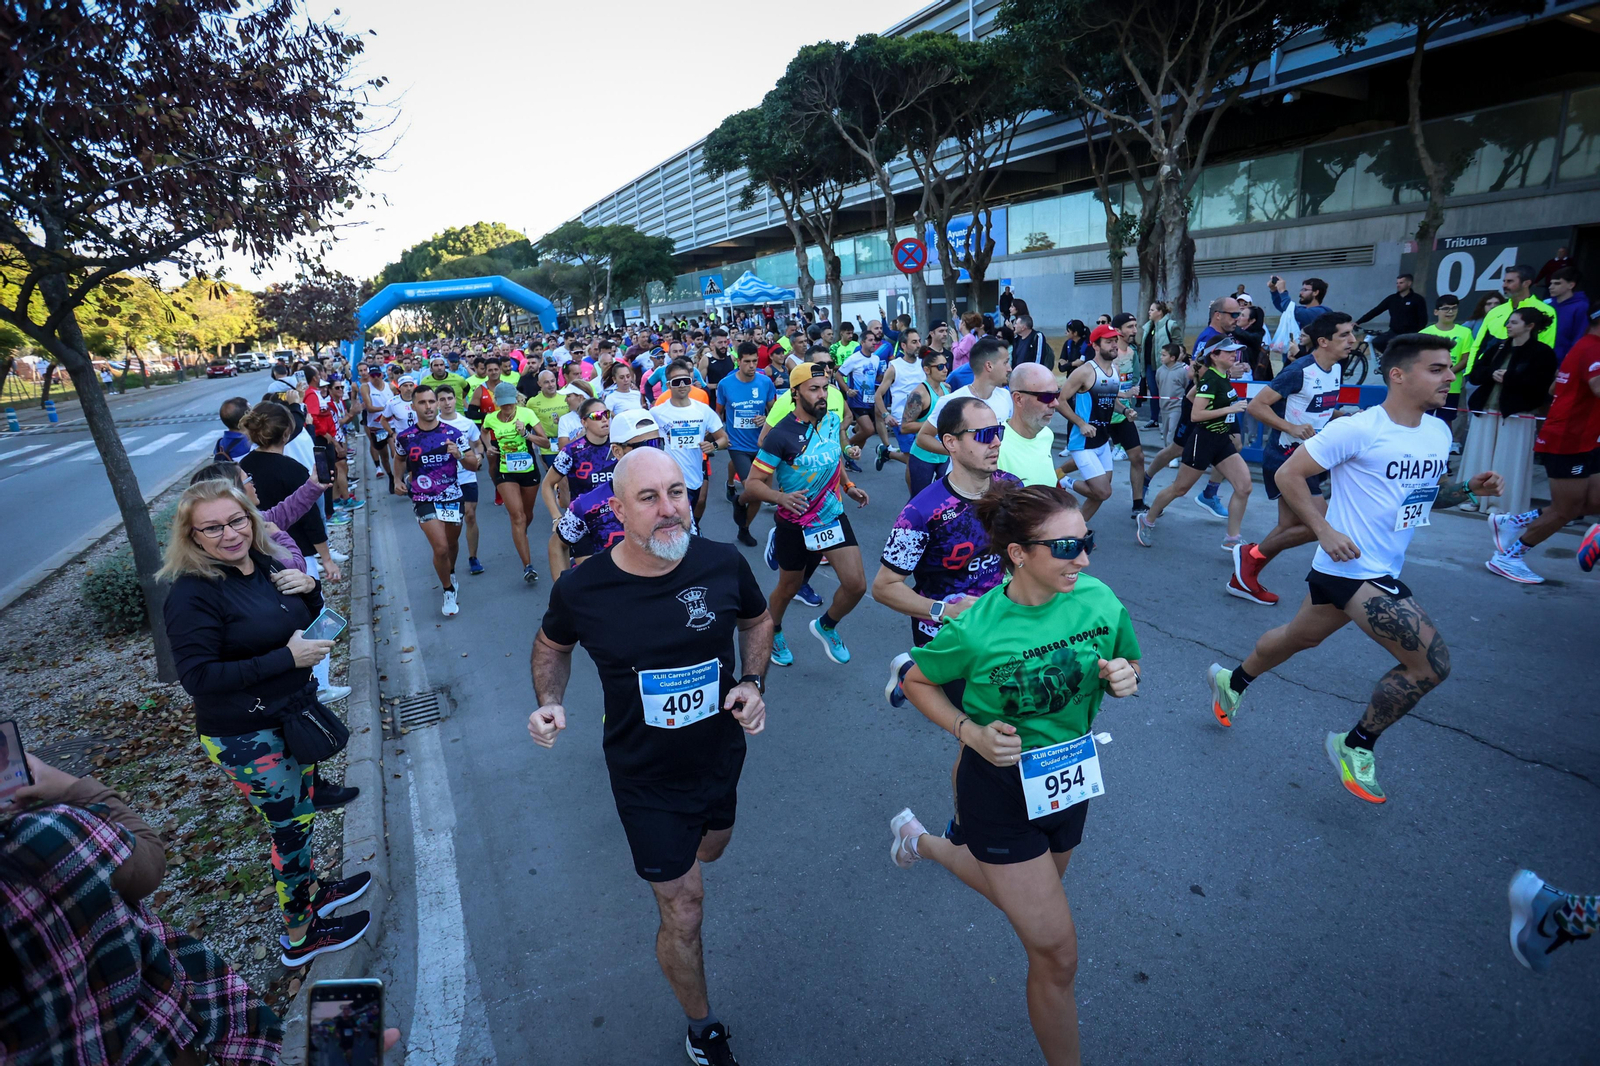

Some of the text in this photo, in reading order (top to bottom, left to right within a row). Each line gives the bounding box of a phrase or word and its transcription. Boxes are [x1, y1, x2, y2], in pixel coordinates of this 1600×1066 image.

[1445, 237, 1487, 249] Tribuna
[1436, 247, 1519, 300] 04
[677, 436, 695, 445] 522
[421, 455, 442, 464] B2B
[513, 460, 528, 468] 779
[441, 509, 455, 518] 258
[1403, 503, 1423, 520] 524
[813, 529, 835, 544] 108
[1022, 626, 1109, 660] CARRERA POPULAR
[667, 671, 691, 679] Carrera
[691, 665, 712, 676] Popular
[659, 680, 682, 688] Ciudad
[691, 675, 706, 683] Jerez
[662, 689, 704, 716] 409
[1031, 739, 1087, 761] XLIII Carrera Popular
[1040, 757, 1061, 768] Ciudad
[1069, 749, 1083, 758] Jerez
[1044, 764, 1085, 799] 954
